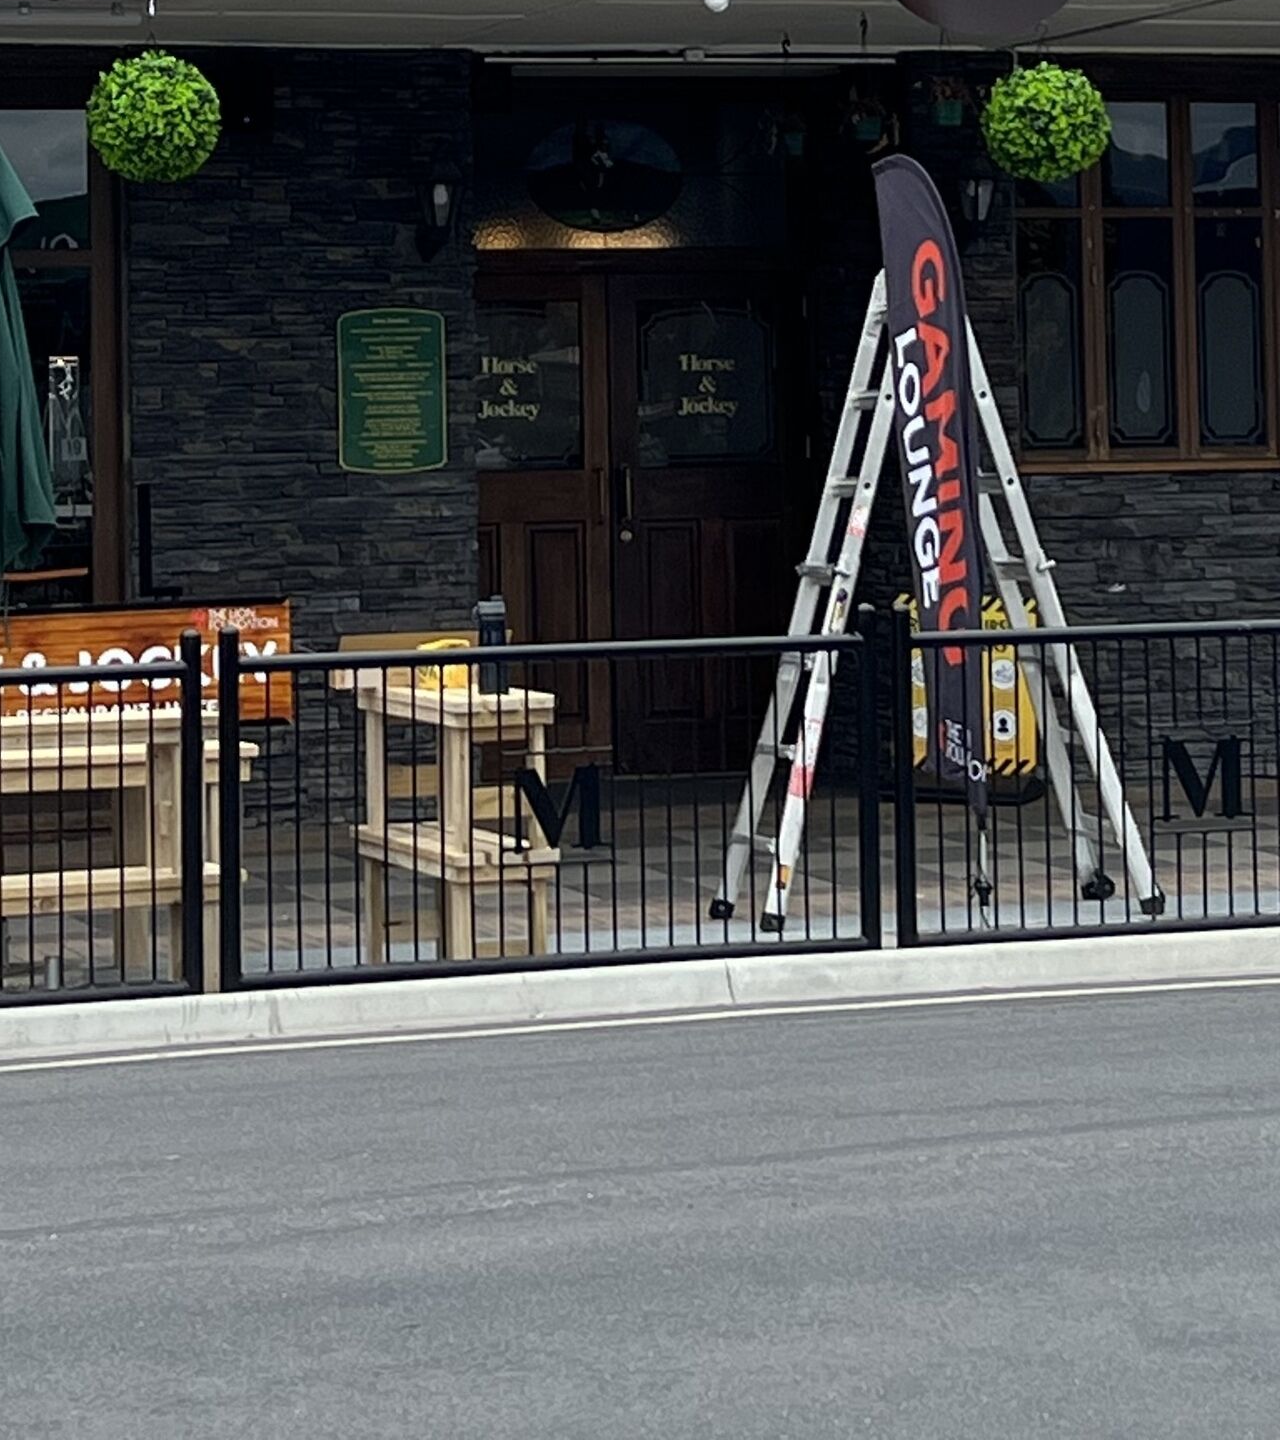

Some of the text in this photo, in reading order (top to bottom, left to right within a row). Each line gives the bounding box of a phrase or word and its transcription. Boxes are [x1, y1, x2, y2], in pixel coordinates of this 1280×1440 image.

[481, 356, 538, 374] Horse
[680, 354, 735, 371] Horse
[499, 378, 518, 396] &
[699, 375, 716, 393] &
[477, 400, 540, 421] Jockey
[678, 397, 738, 418] Jockey
[911, 239, 968, 667] GAMING
[894, 327, 941, 609] LOUNGE
